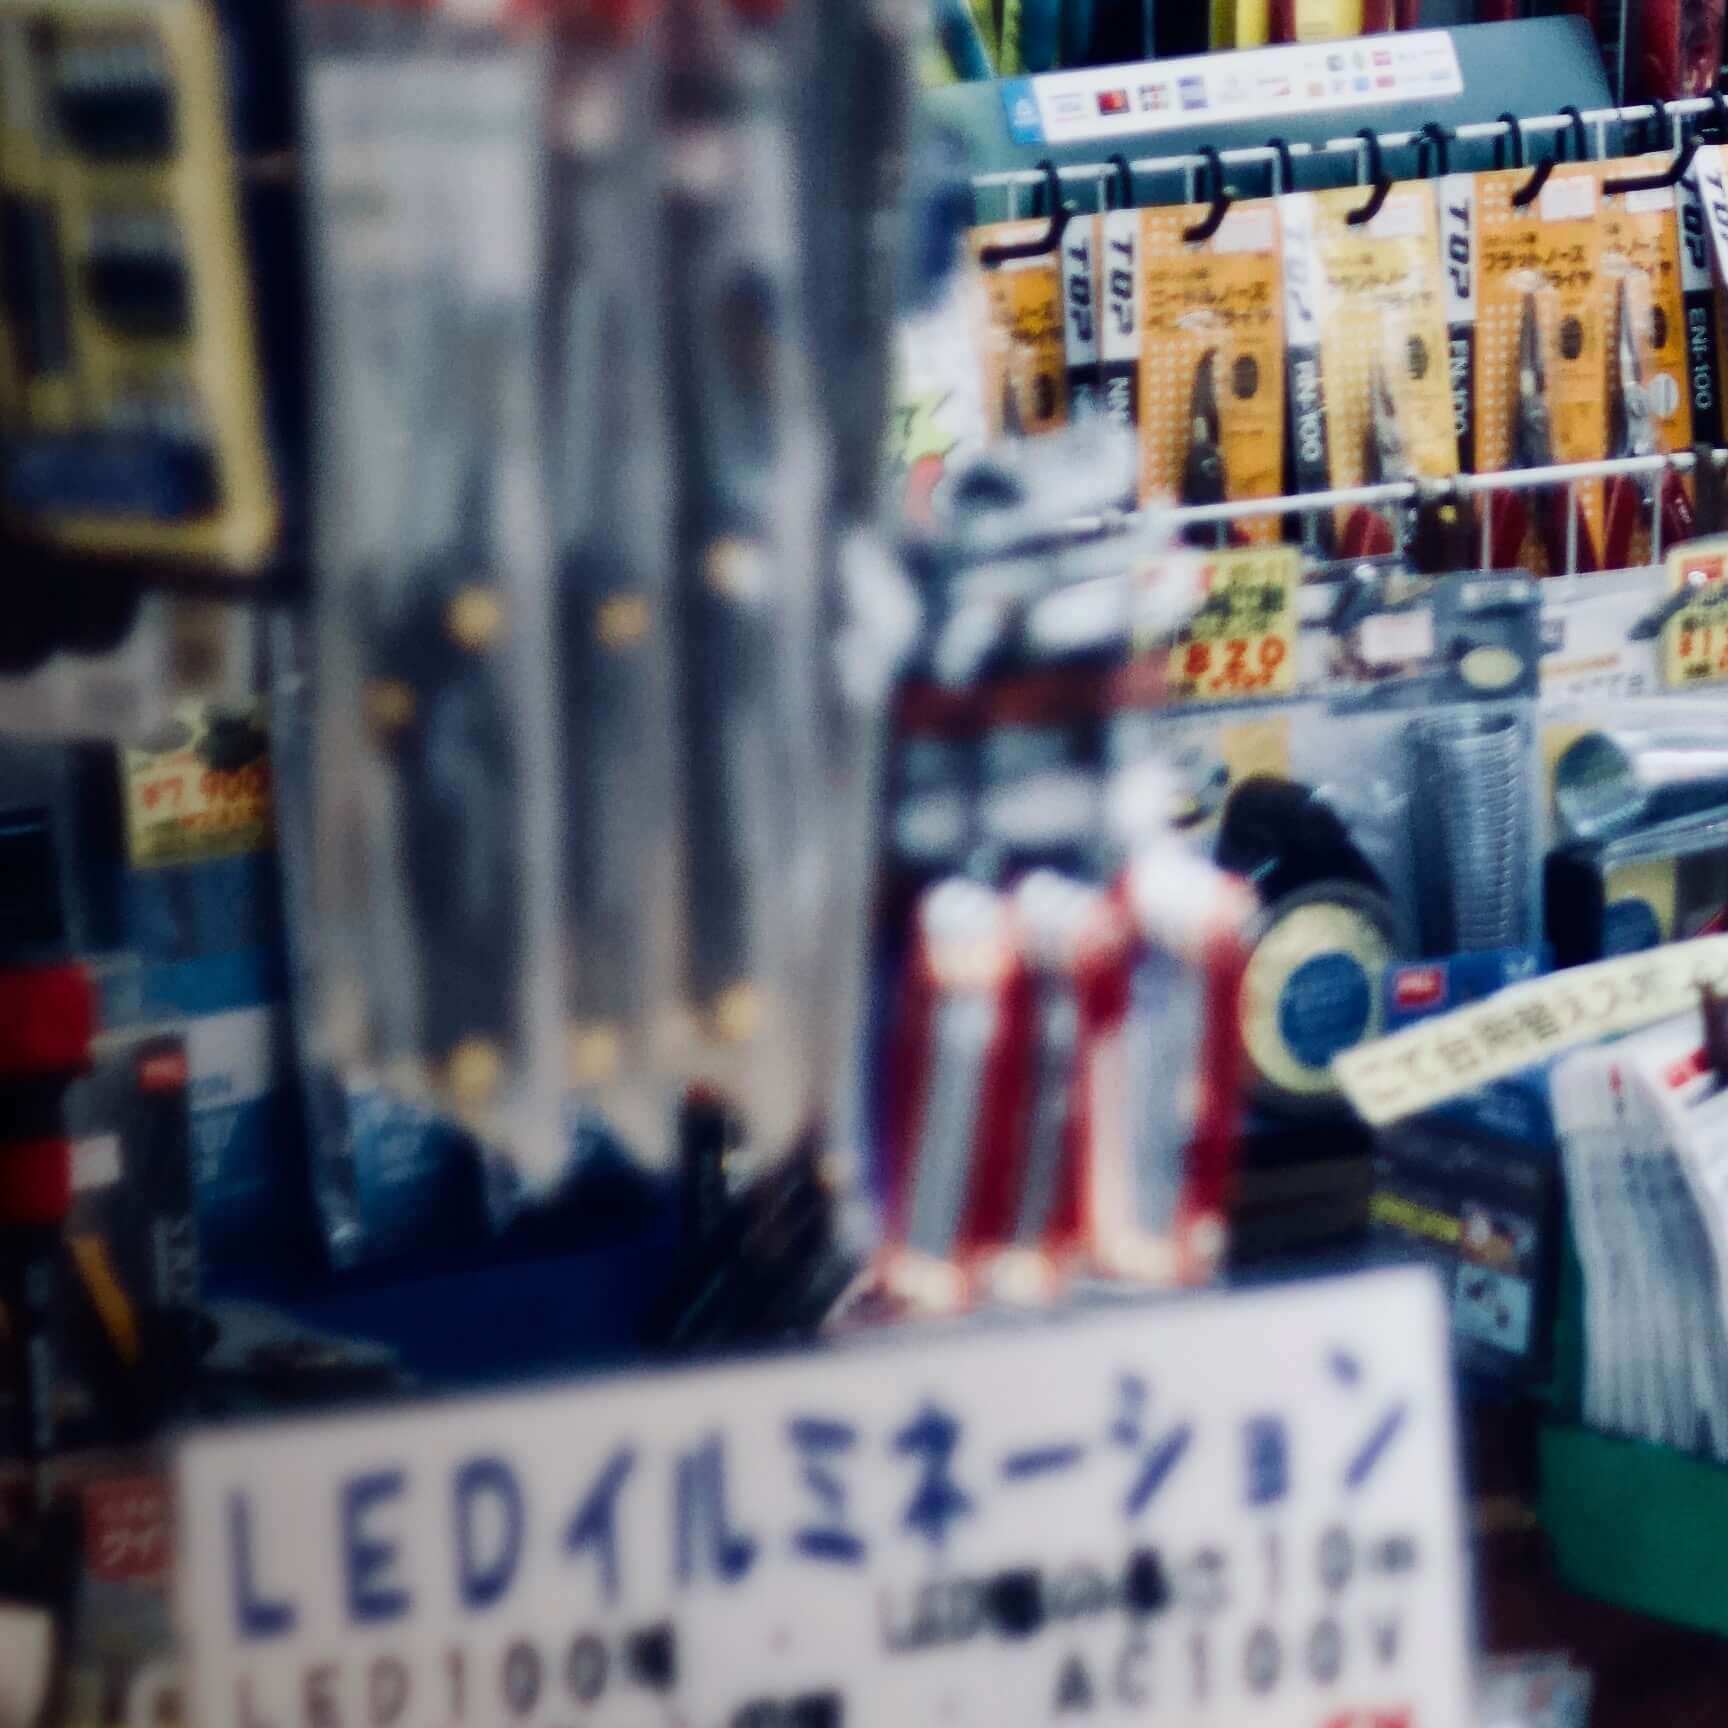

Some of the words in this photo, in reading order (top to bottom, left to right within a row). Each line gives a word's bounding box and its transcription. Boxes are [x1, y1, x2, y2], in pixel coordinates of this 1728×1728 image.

[1066, 236, 1093, 343] TOP
[1107, 230, 1136, 336] TOP
[1446, 197, 1471, 300] TOP
